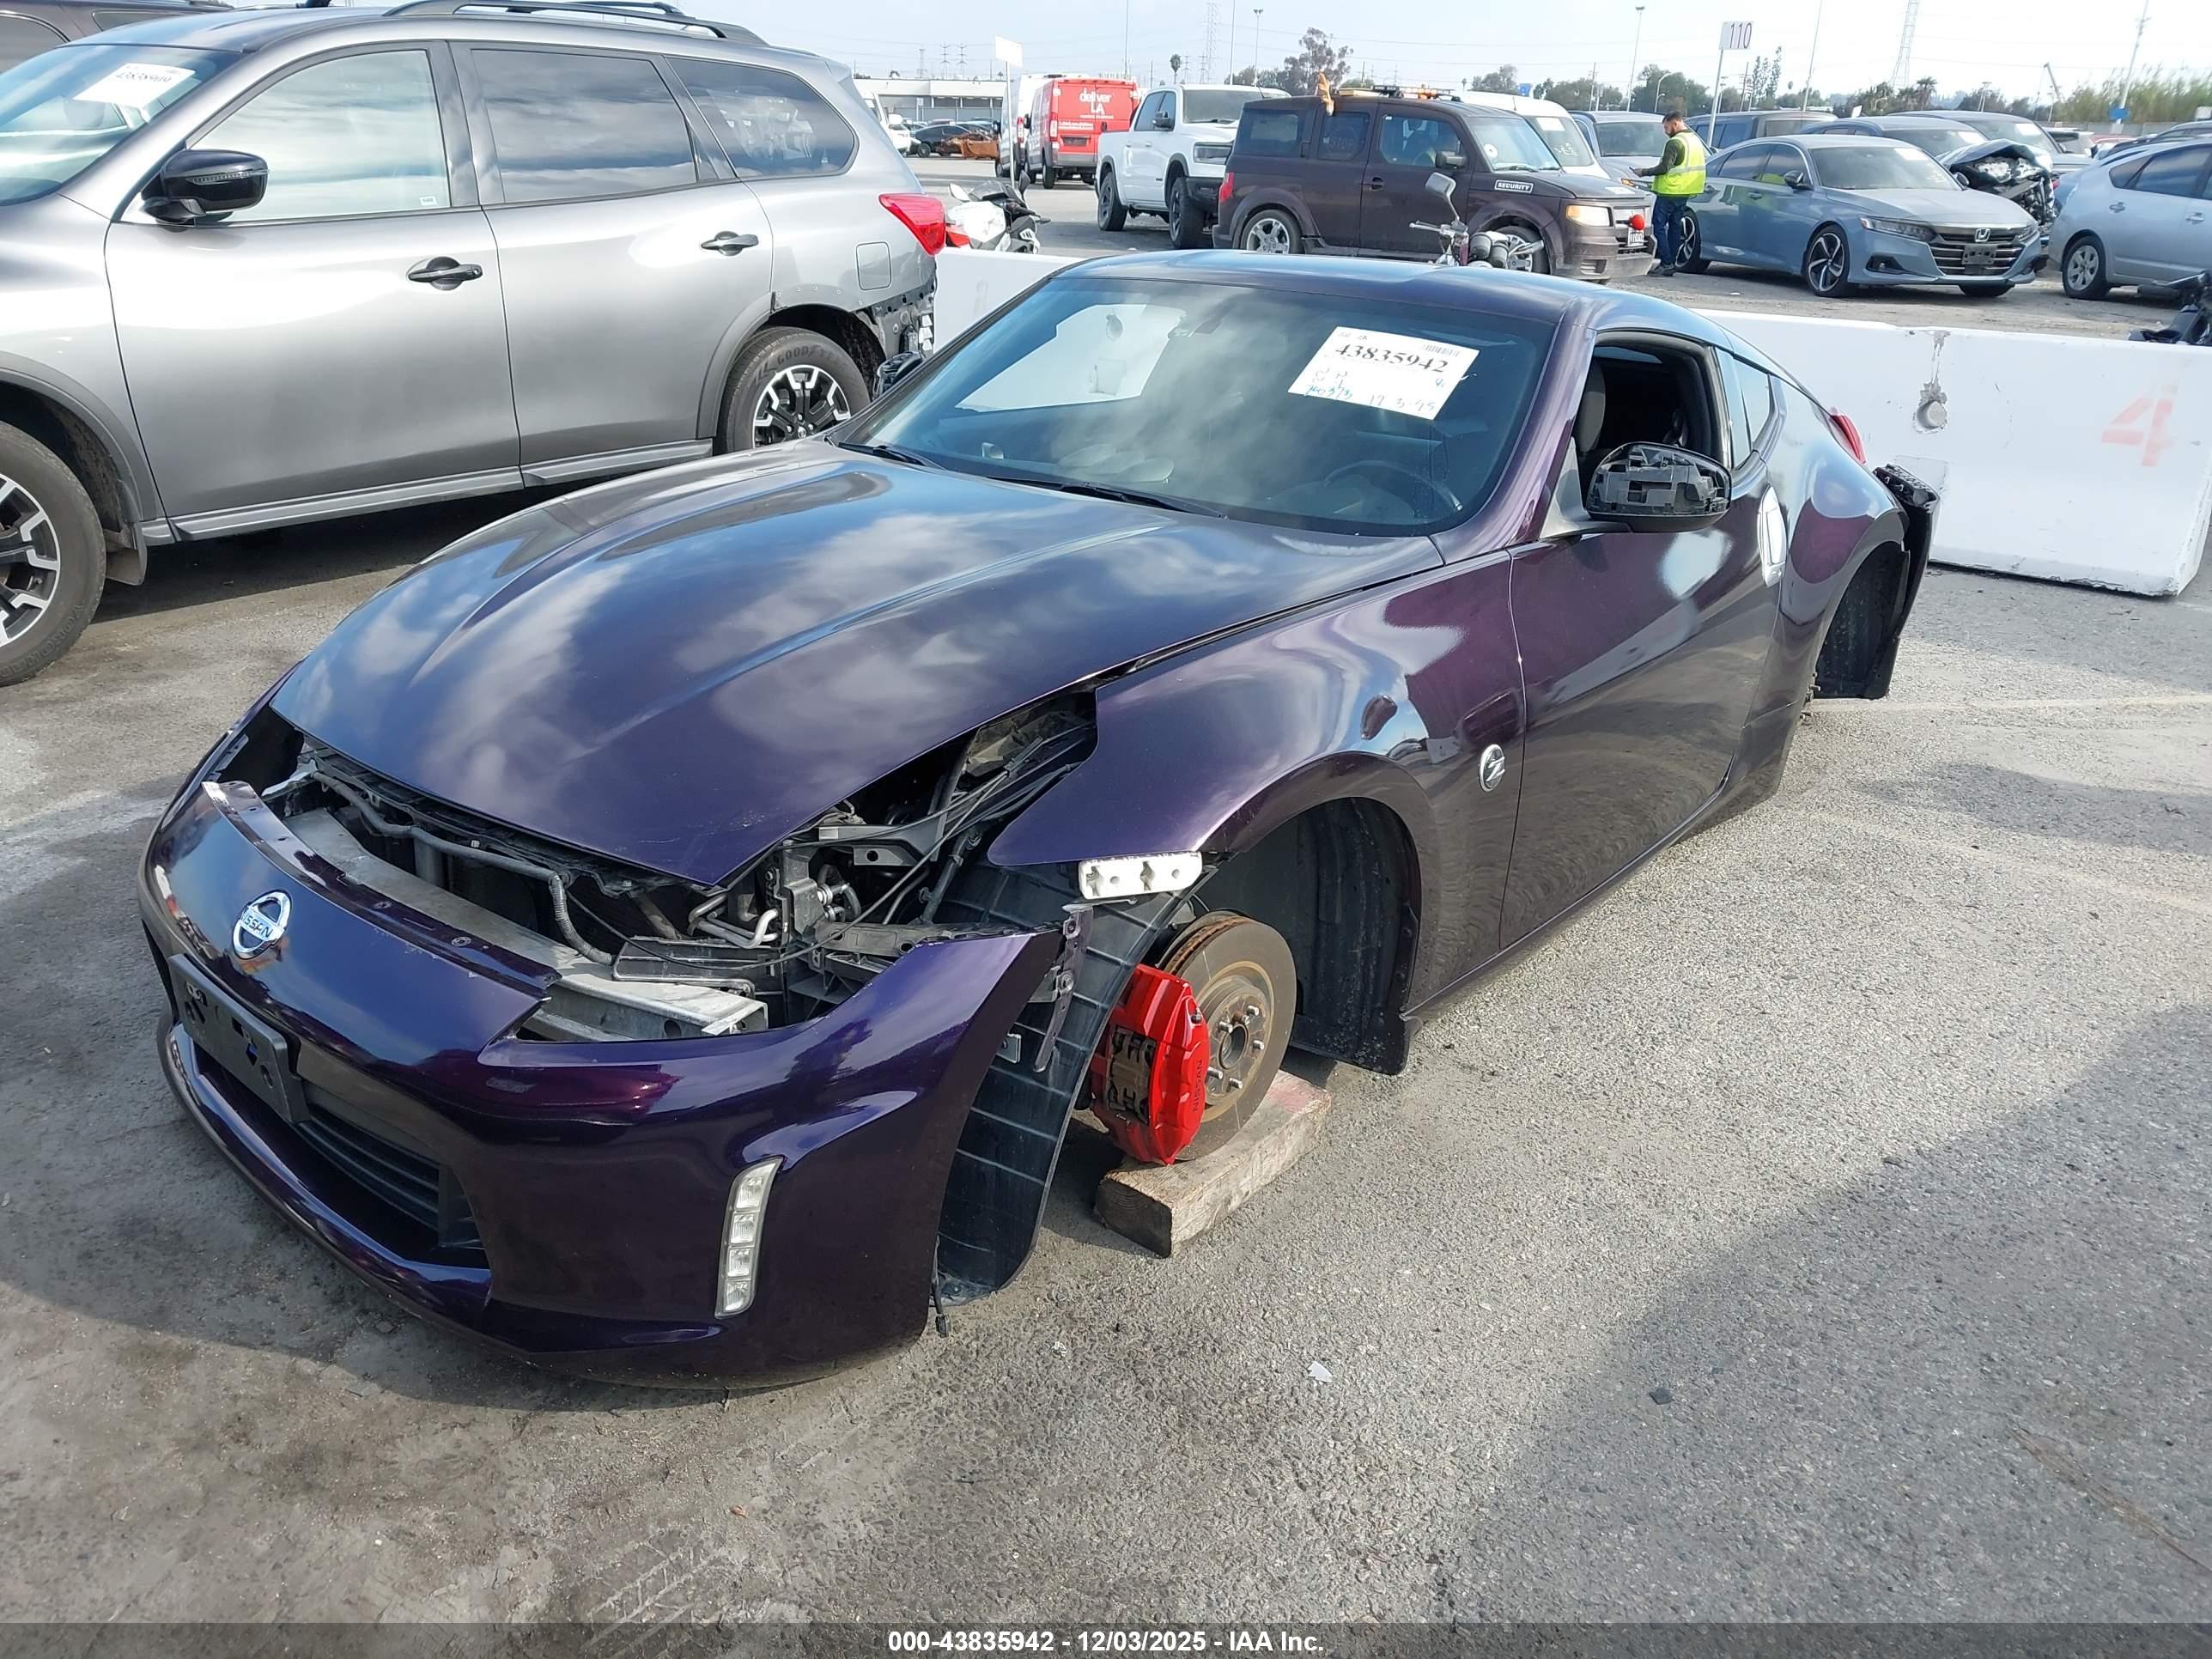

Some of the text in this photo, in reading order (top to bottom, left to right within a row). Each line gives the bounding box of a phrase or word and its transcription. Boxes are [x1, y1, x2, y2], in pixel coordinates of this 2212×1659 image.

[1729, 22, 1752, 49] 110
[1079, 88, 1112, 102] deliver
[1091, 102, 1106, 115] LA
[1498, 182, 1530, 191] SECURITY
[1335, 344, 1448, 373] 43835942
[2101, 392, 2174, 466] 4
[1193, 1058, 1203, 1113] NISSAN
